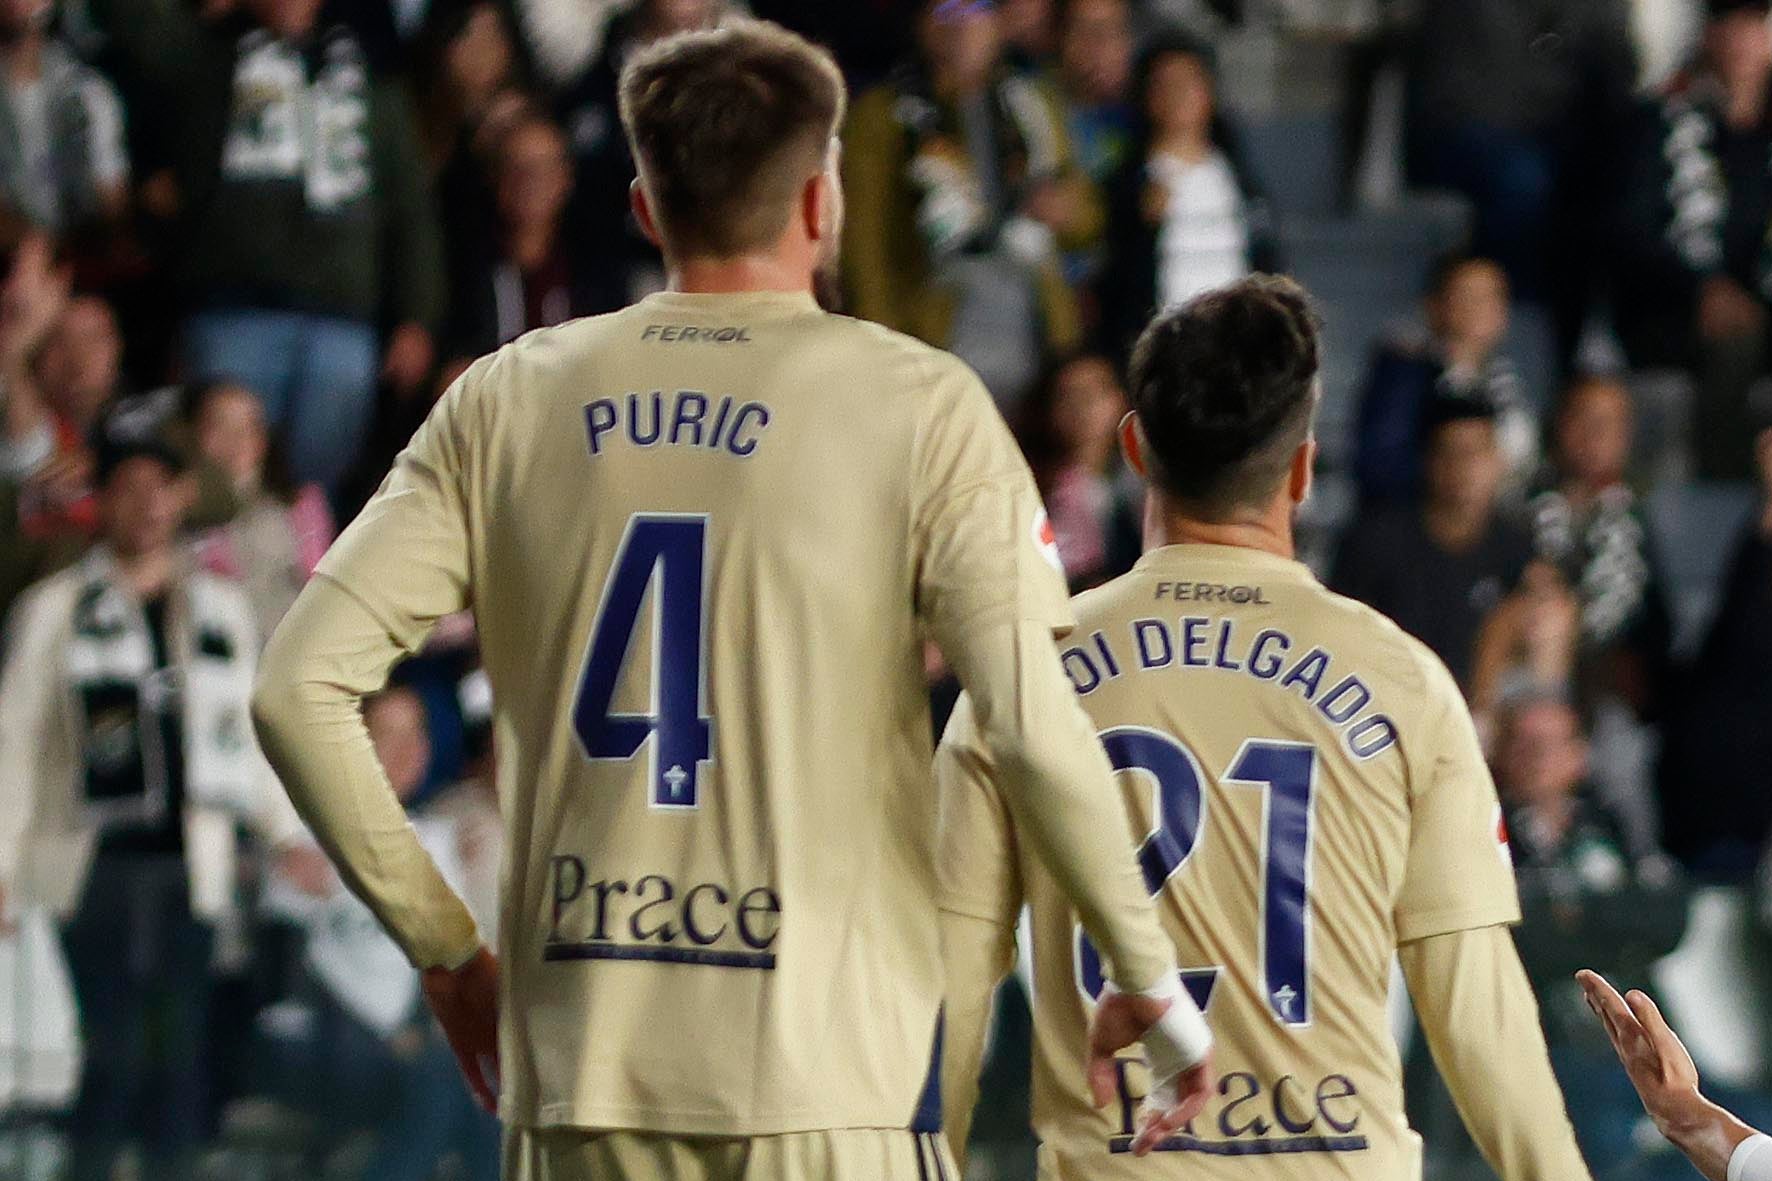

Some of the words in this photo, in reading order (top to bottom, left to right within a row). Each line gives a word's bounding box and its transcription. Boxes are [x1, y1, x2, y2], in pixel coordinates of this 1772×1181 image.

[582, 390, 770, 457] PURIC
[1155, 581, 1271, 604] FERROL
[571, 512, 713, 809] 4
[1132, 615, 1398, 760] DELGADO
[546, 854, 782, 950] Prace
[1113, 1056, 1360, 1138] Pace
